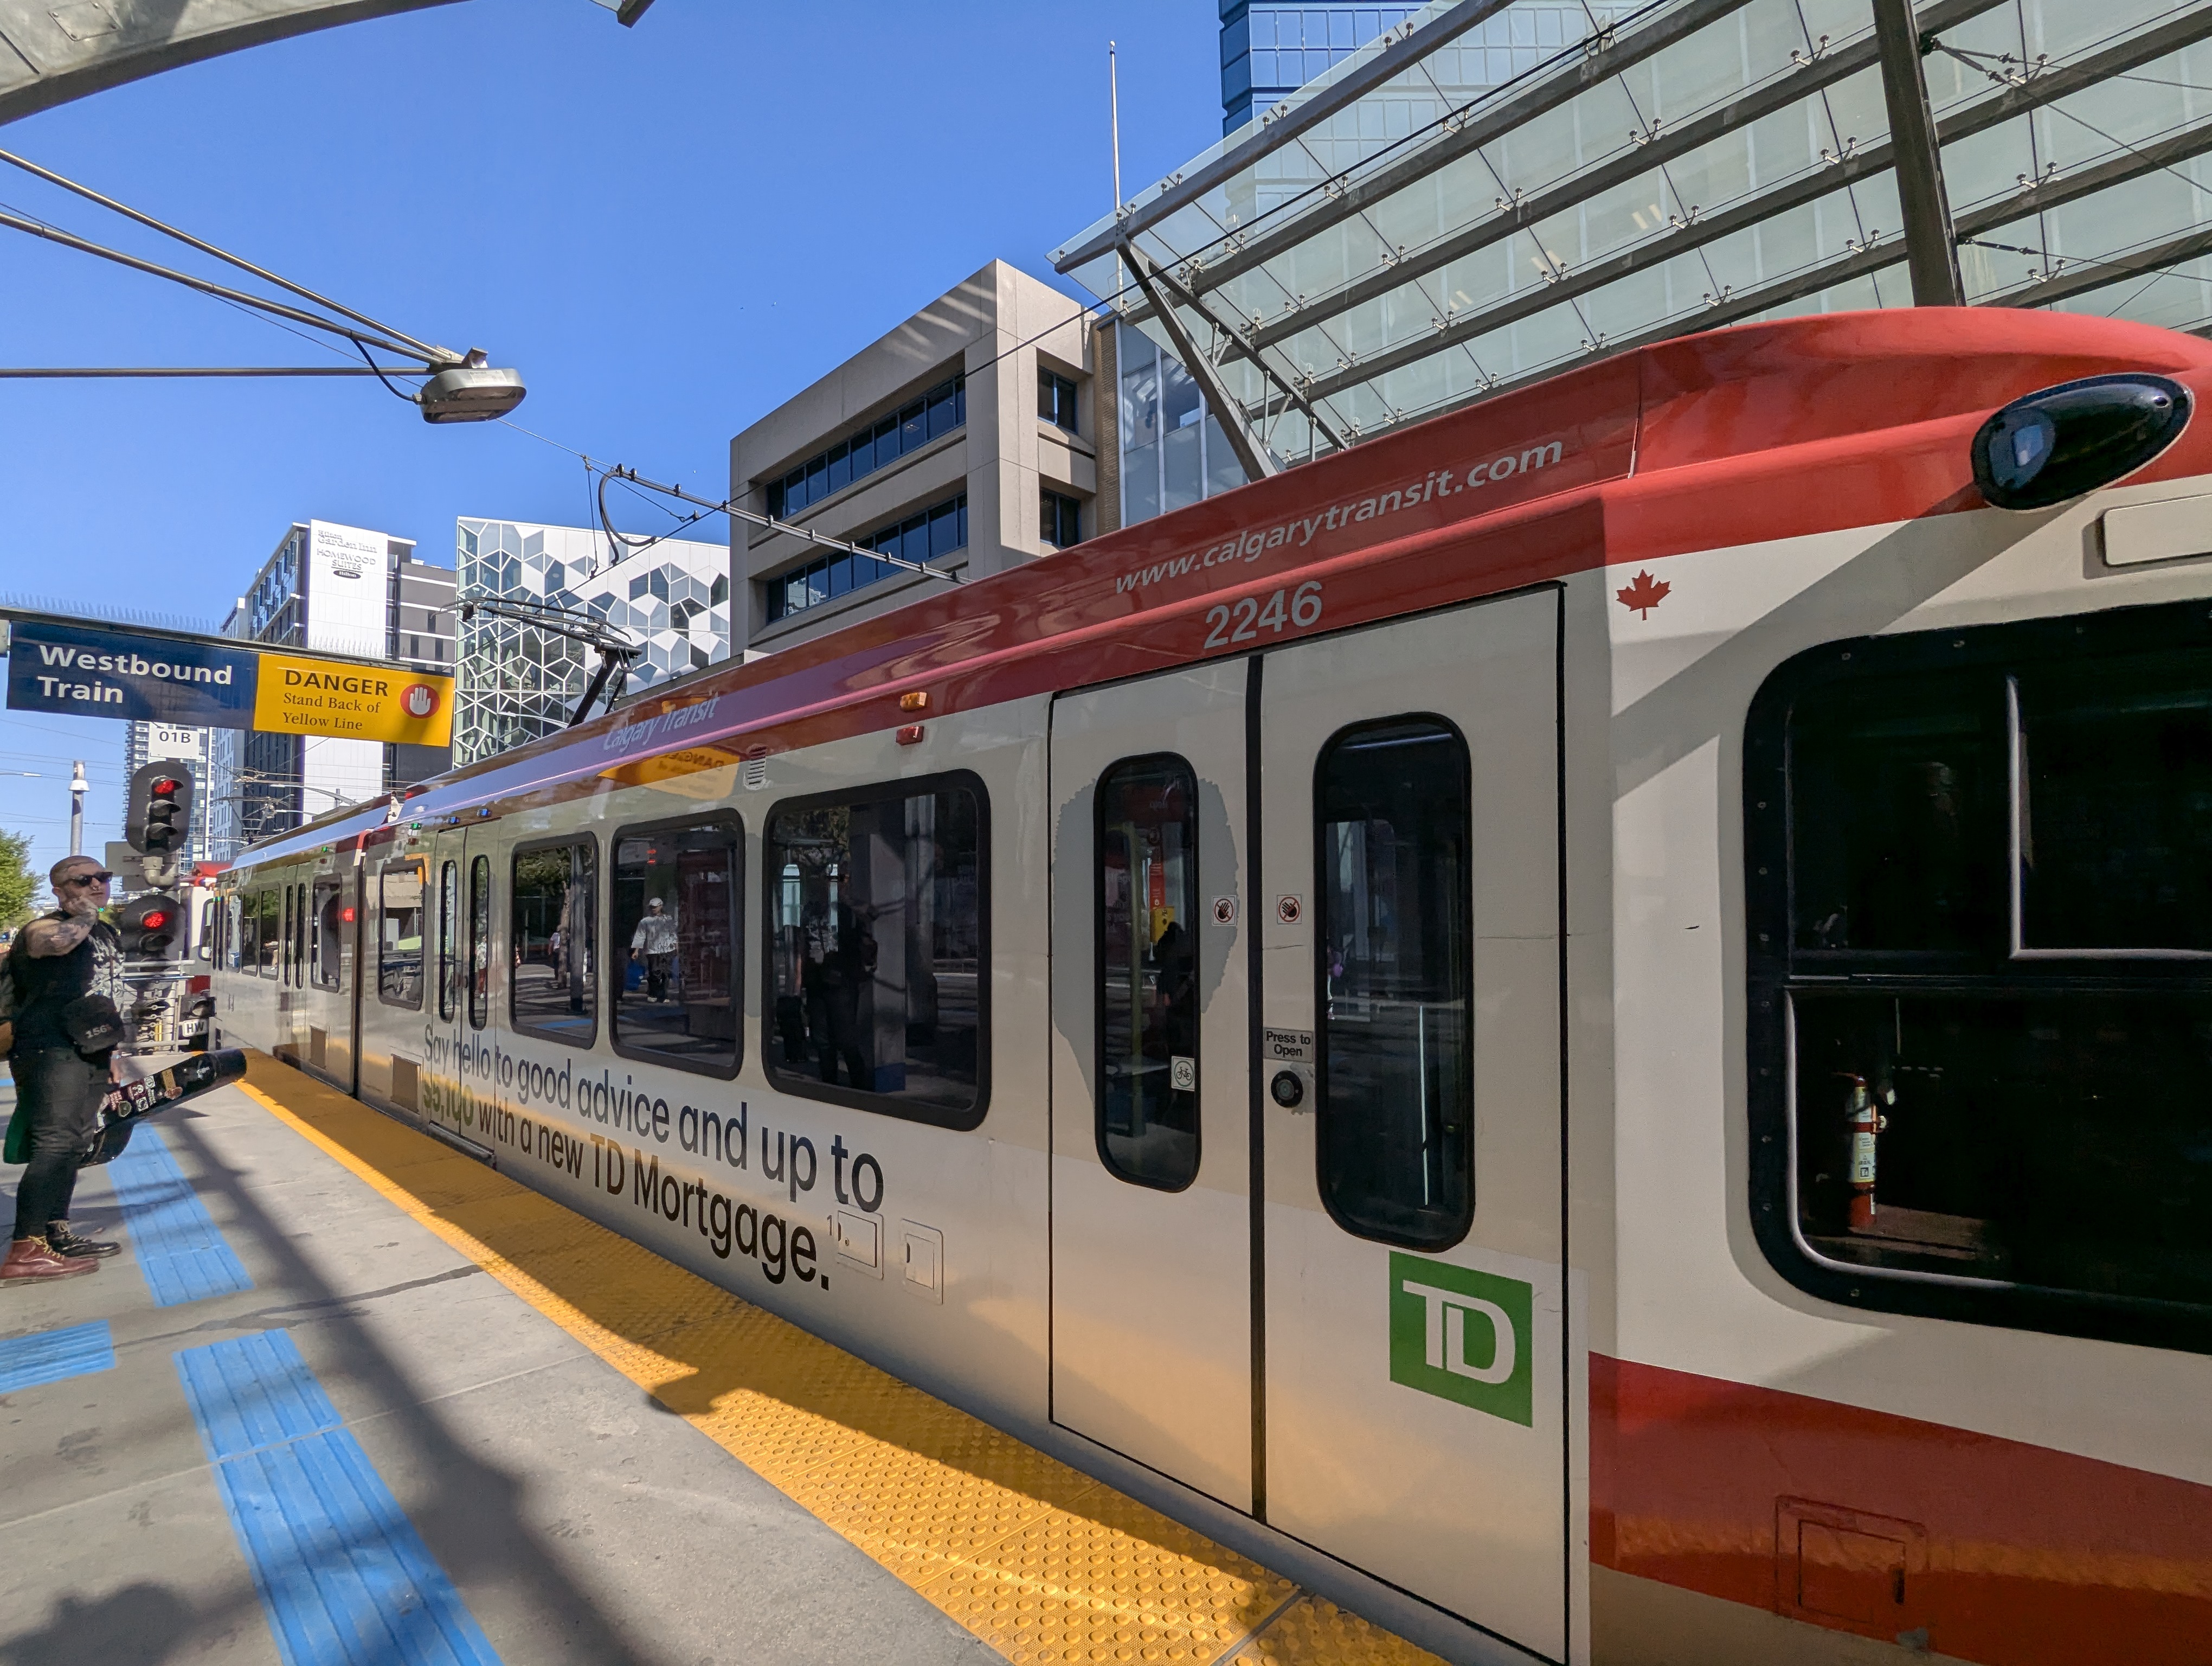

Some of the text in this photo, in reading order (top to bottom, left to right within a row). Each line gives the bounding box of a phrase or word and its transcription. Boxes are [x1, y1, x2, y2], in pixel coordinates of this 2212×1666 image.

[1115, 440, 1564, 595] www.calgarytransit.com
[318, 529, 343, 540] Hilton
[318, 535, 378, 553] Garden Inn
[317, 548, 376, 565] HOMEWOOD
[332, 559, 362, 571] SUITES
[1203, 580, 1324, 650] 2246
[39, 644, 233, 685] Westbound
[37, 676, 124, 704] Train
[285, 669, 389, 697] DANGER
[283, 692, 382, 713] Stand Back of
[282, 712, 363, 730] Yellow Line
[603, 696, 721, 753] Calgary Transit
[159, 730, 191, 744] 01B
[186, 1021, 204, 1034] HW
[1265, 1030, 1311, 1045] Press to
[1273, 1043, 1303, 1058] Open
[424, 1023, 884, 1213] Say hello to good advice and up to
[478, 1097, 515, 1146] with
[520, 1117, 532, 1155] a
[538, 1123, 584, 1180] new
[589, 1132, 626, 1194] TD
[634, 1148, 829, 1291] Mortgage.
[1403, 1279, 1516, 1384] TD
